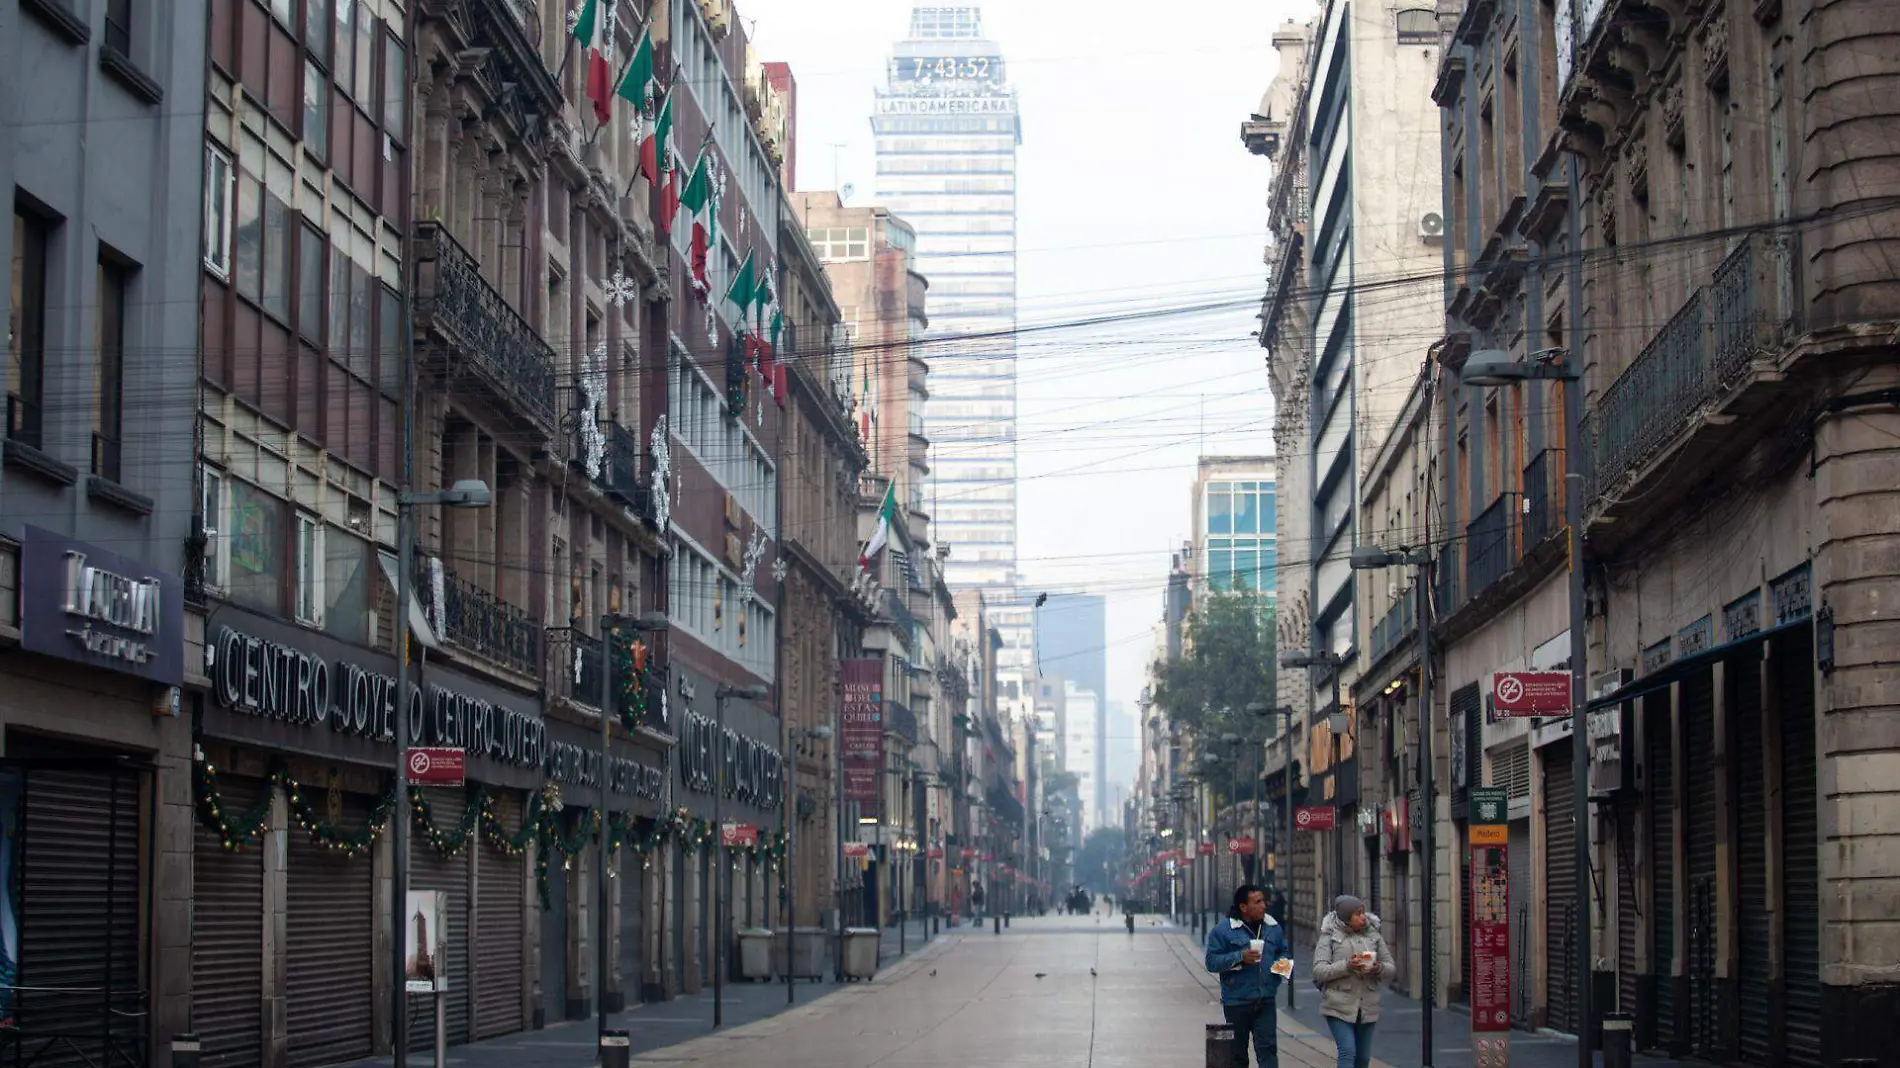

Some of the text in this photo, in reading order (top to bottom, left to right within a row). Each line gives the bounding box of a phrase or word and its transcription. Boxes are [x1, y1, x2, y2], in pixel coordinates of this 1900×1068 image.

[881, 100, 1007, 113] LATINOAMERICANA
[913, 57, 989, 78] 7:43:52
[217, 625, 329, 727] CENTRO
[332, 660, 423, 743] JOYEO
[430, 683, 547, 768] CENTRO JOYERO
[682, 707, 741, 796] CENRO
